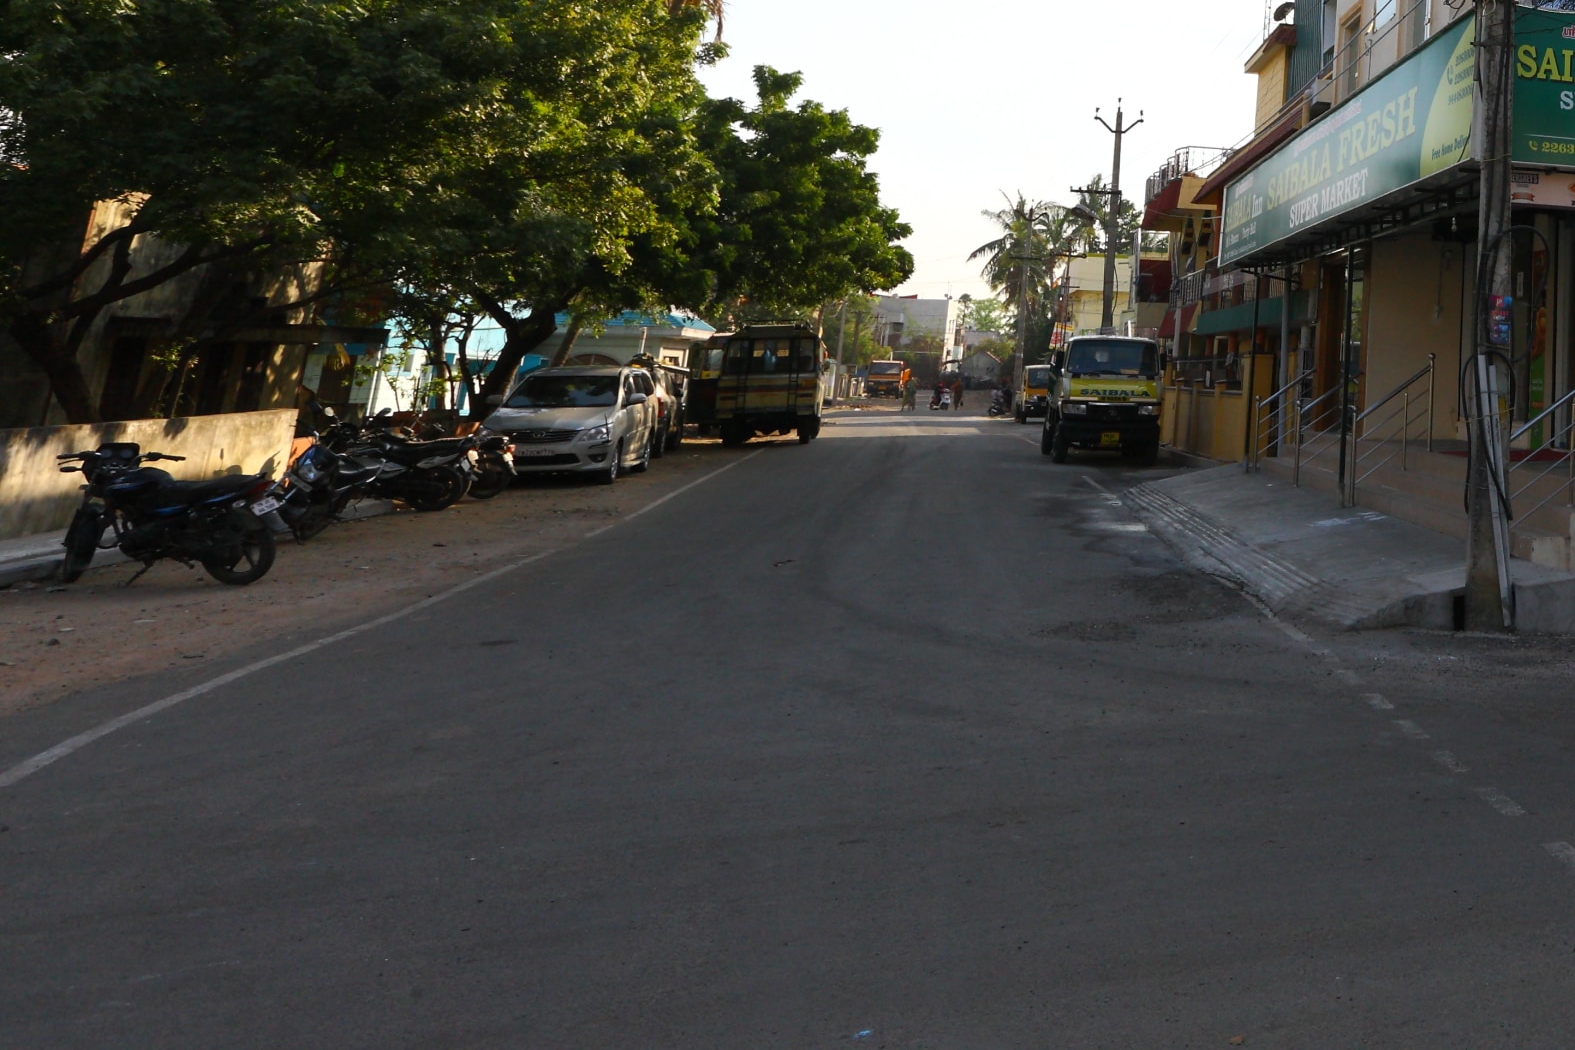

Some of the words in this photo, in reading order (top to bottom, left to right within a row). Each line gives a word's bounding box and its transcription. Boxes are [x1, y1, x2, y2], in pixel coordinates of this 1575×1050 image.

[1267, 142, 1332, 211] SAIBALA
[1337, 86, 1418, 172] FRESH
[1511, 173, 1538, 183] ERSHEY'S
[1289, 192, 1319, 229] SUPER
[1320, 166, 1368, 215] MARKET
[1080, 388, 1151, 397] SAIBALA
